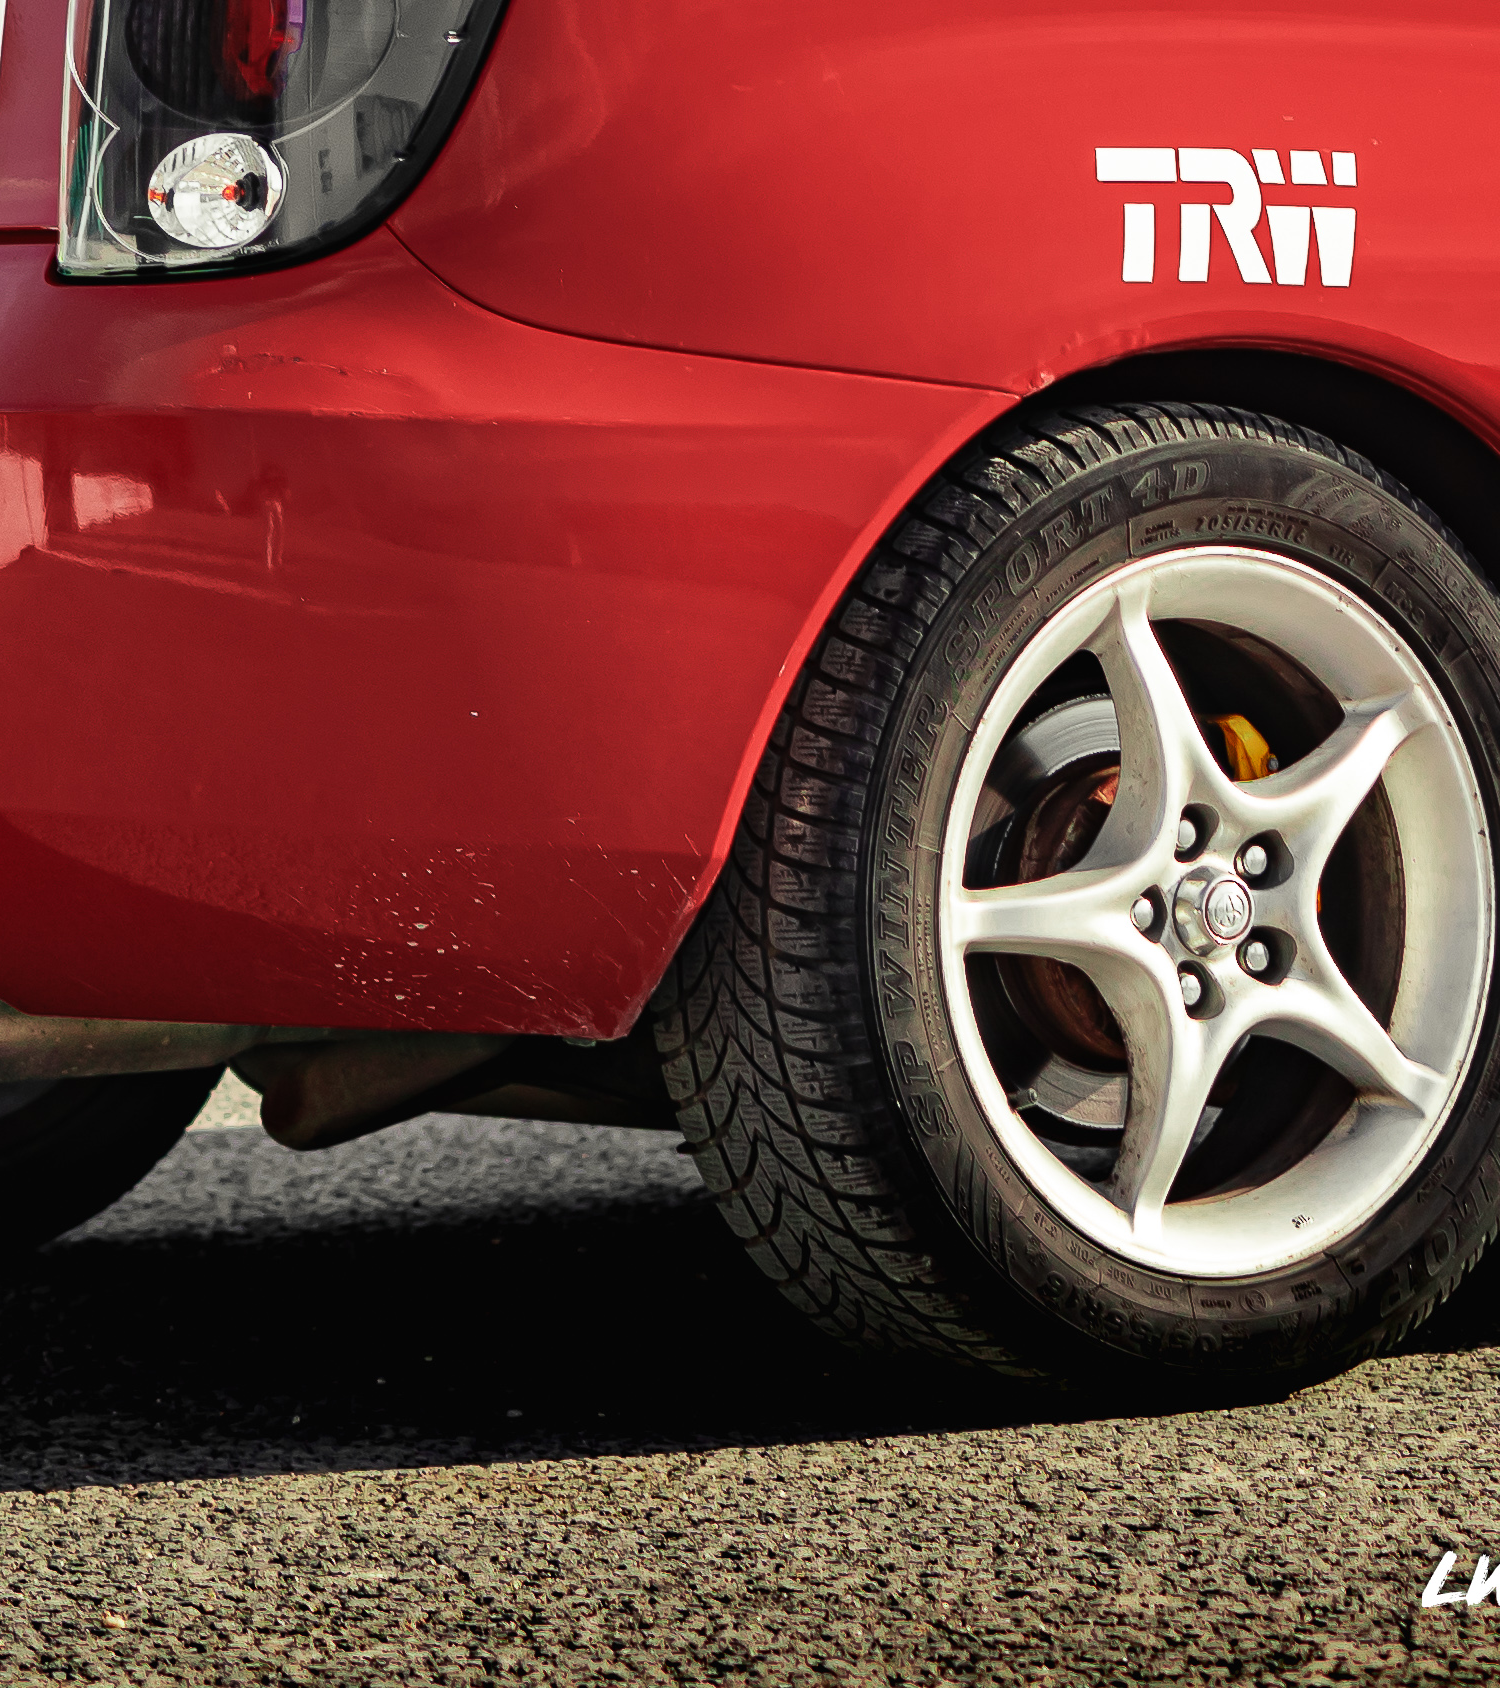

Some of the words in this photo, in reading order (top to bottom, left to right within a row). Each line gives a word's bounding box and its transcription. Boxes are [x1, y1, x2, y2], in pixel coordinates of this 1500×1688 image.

[1095, 147, 1358, 287] TRW
[1130, 461, 1211, 507] 4D
[1194, 514, 1308, 544] 205/55R16
[944, 484, 1115, 686] SPORT
[879, 693, 950, 1018] WINTER
[895, 1040, 957, 1138] SP
